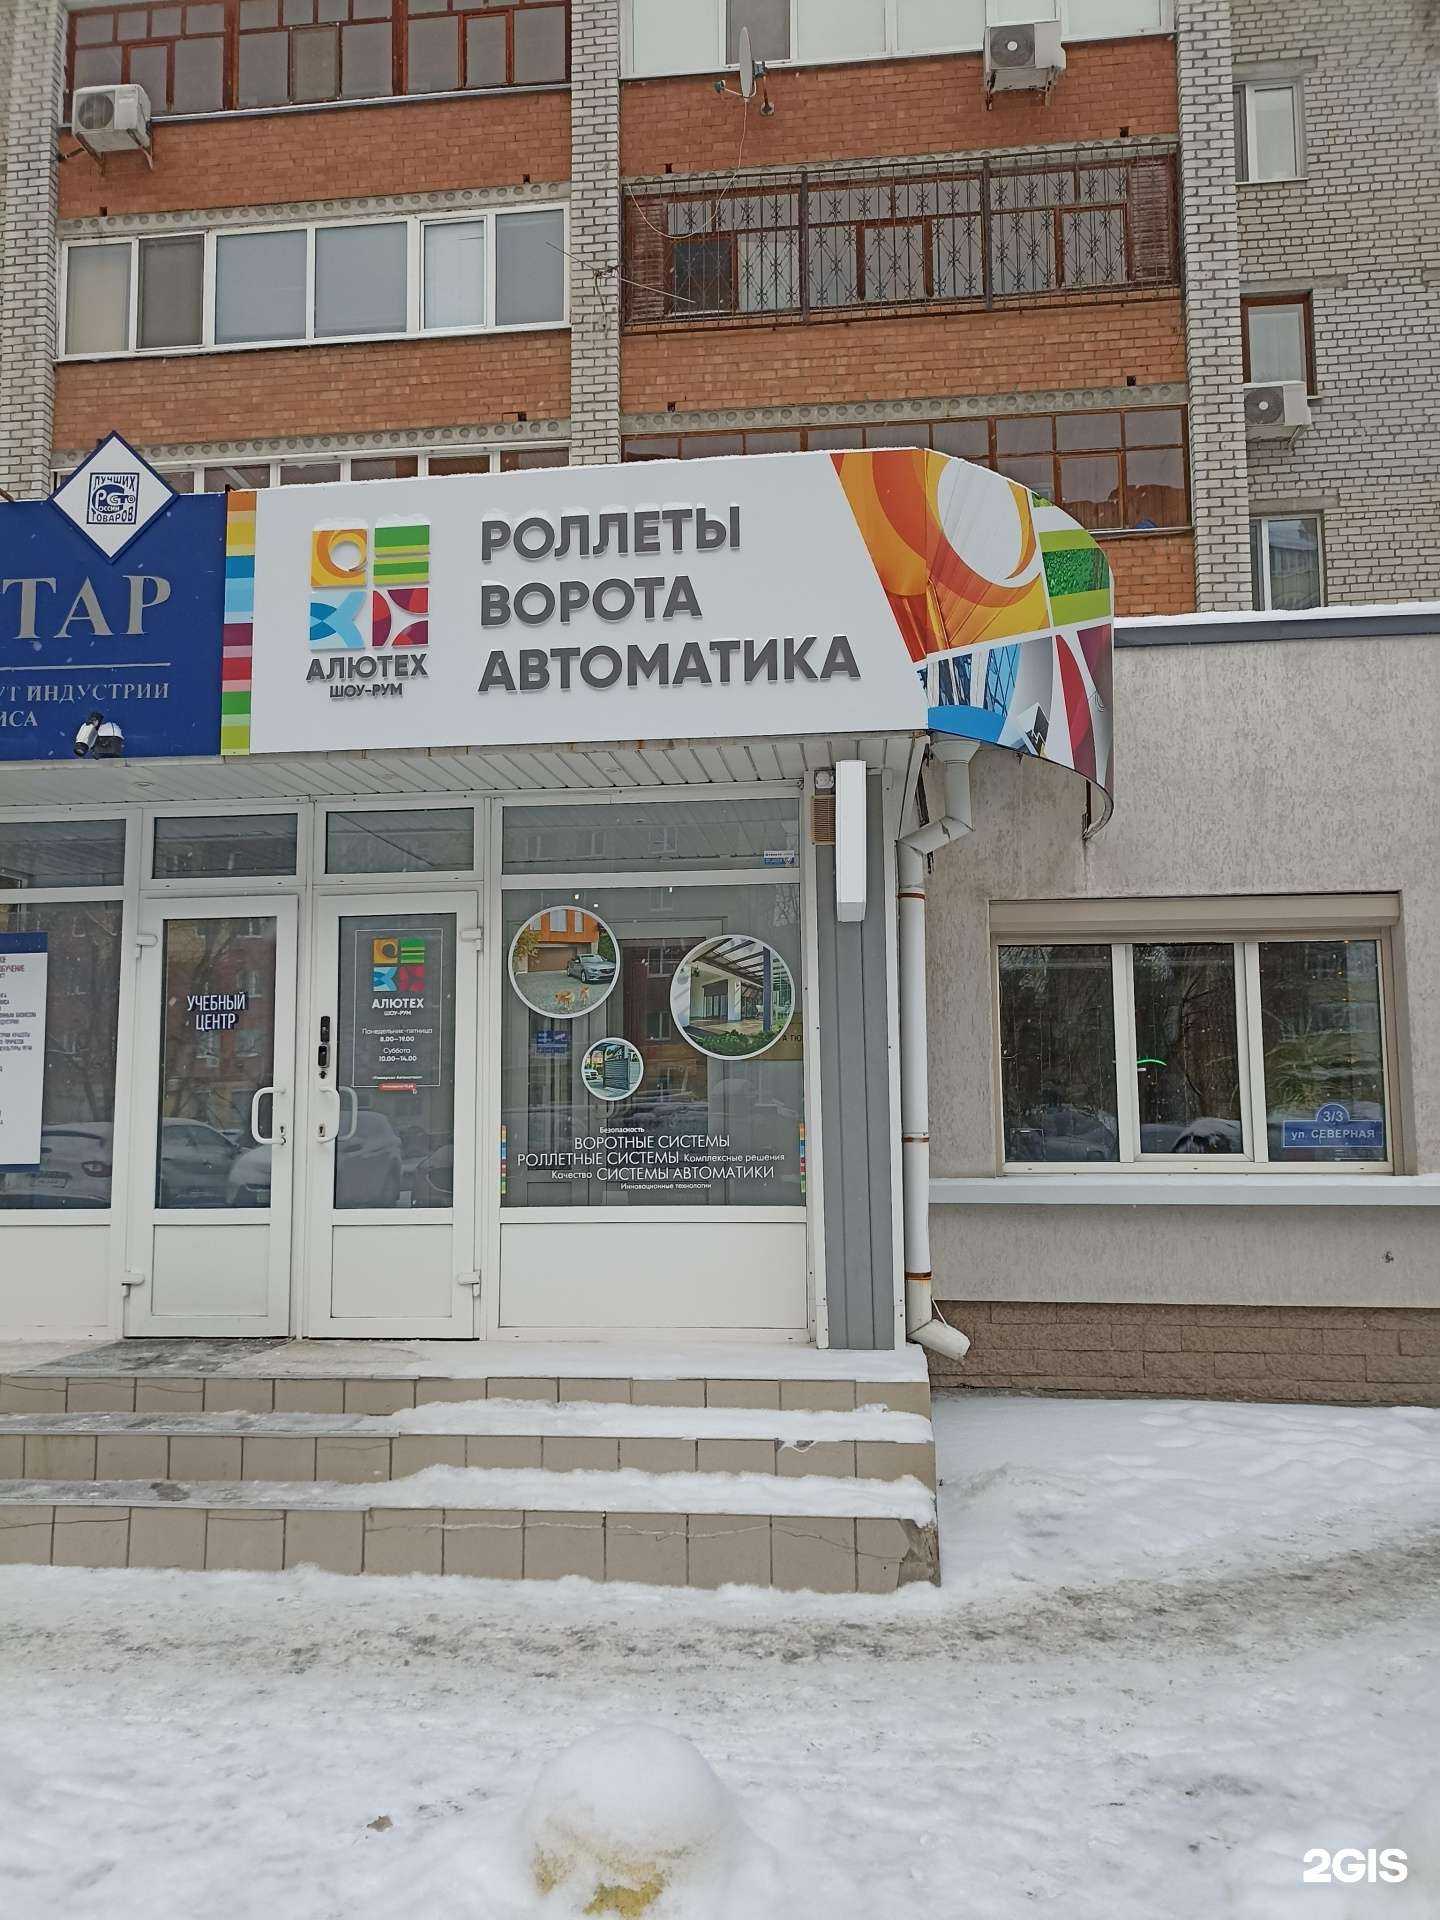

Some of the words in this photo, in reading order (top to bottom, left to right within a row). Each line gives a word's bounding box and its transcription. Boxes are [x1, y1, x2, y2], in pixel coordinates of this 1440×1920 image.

[93, 475, 136, 491] ЛУЧШИХ
[91, 506, 134, 522] ТОВАРОВ
[481, 504, 742, 562] РОЛЛЕТЫ
[2, 575, 171, 639] ТАР
[480, 575, 703, 628] ВОРОТА
[306, 653, 429, 682] АЛЮТЕХ
[478, 635, 861, 694] АВТОМАТИКА
[27, 683, 169, 703] ИНДУСТРИИ
[328, 682, 404, 699] ШОУ-РУМ
[187, 992, 246, 1012] УЧЕБНЫЙ
[371, 998, 425, 1009] АЛЮТЕХ
[195, 1013, 237, 1031] ЦЕНТР
[383, 1047, 411, 1055] Суббота
[1323, 1110, 1344, 1122] 3/3
[600, 1126, 645, 1134] Безопасность
[1311, 1129, 1375, 1139] СЕВЕРНАЯ
[575, 1136, 655, 1150] ВОРОТНЫЕ
[658, 1134, 731, 1149] СИСТЕМЫ
[517, 1152, 603, 1167] РОЛЛЕТНЫЕ
[607, 1151, 680, 1165] СИСТЕМЫ
[684, 1153, 743, 1163] Комплексные
[745, 1152, 785, 1163] решения
[551, 1169, 593, 1180] Качество
[597, 1167, 669, 1181] СИСТЕМЫ
[672, 1165, 775, 1180] АВТОМАТИКИ
